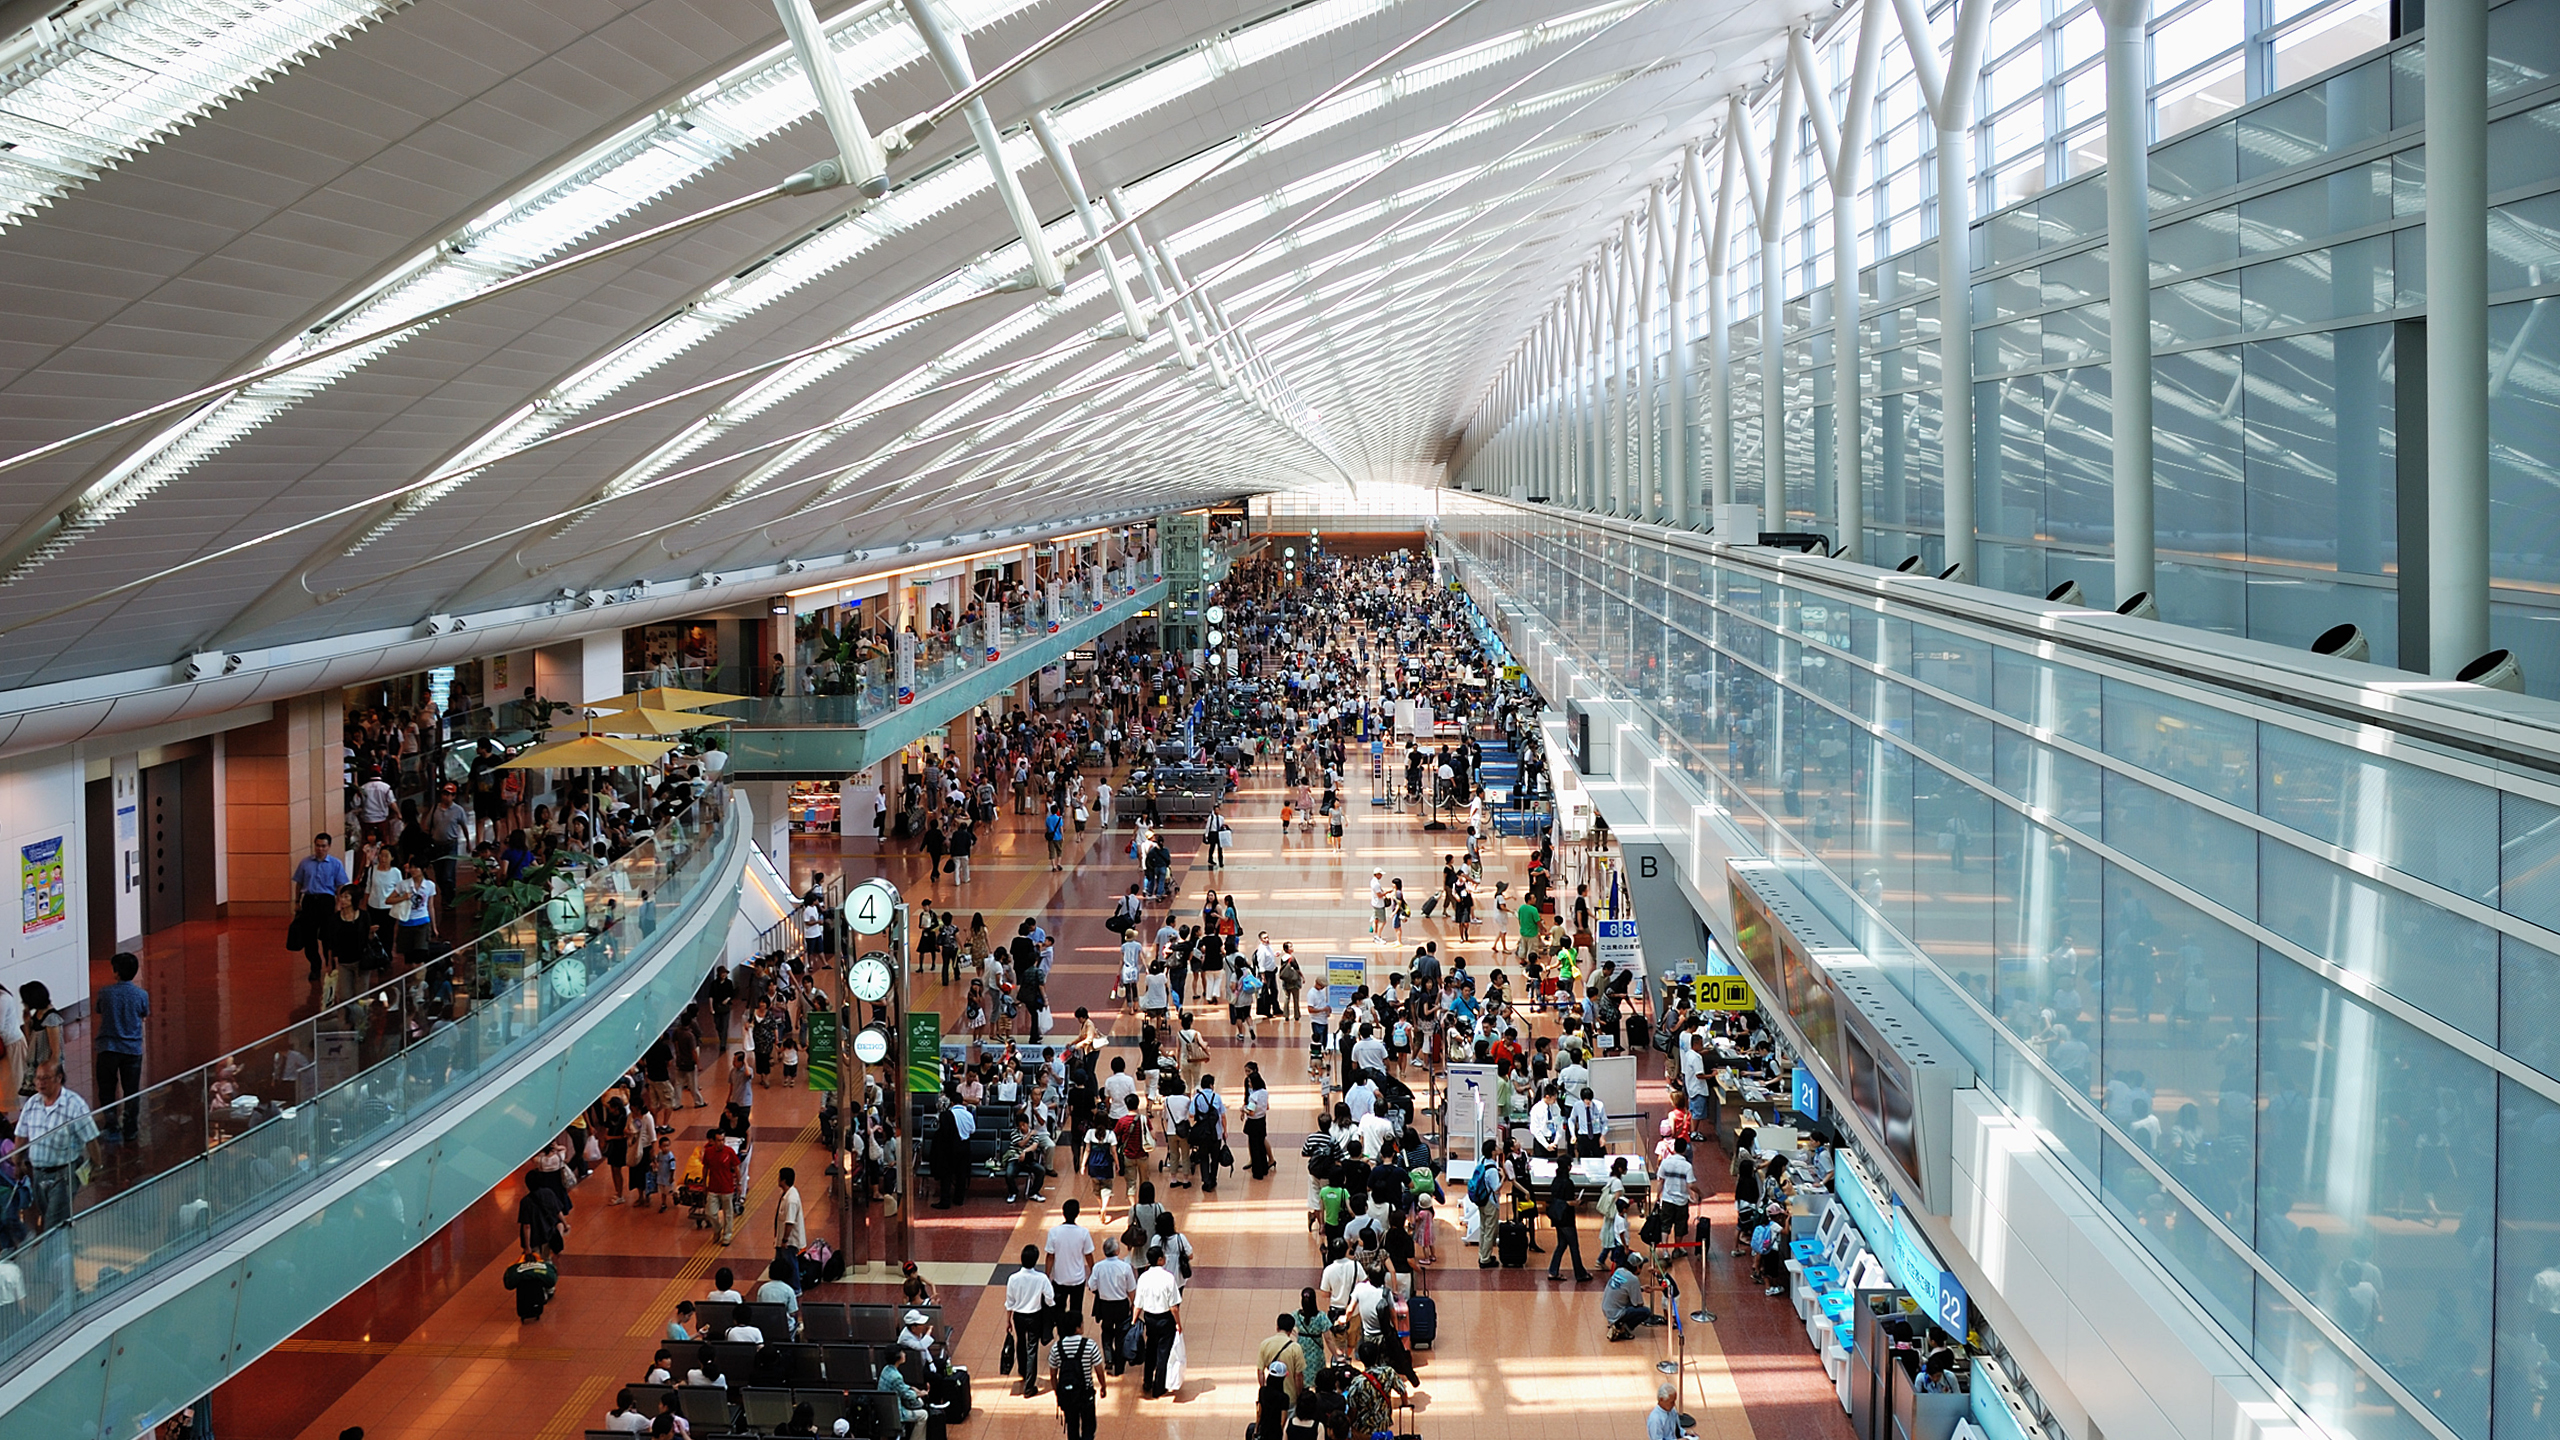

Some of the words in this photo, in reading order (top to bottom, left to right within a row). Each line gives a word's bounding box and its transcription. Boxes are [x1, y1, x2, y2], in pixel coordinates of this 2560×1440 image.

[1211, 609, 1219, 621] 3
[1503, 668, 1513, 677] 17
[1641, 856, 1659, 878] B
[858, 894, 877, 925] 4
[1700, 982, 1720, 1003] 20
[1802, 1082, 1814, 1110] 21
[1941, 1289, 1961, 1329] 22
